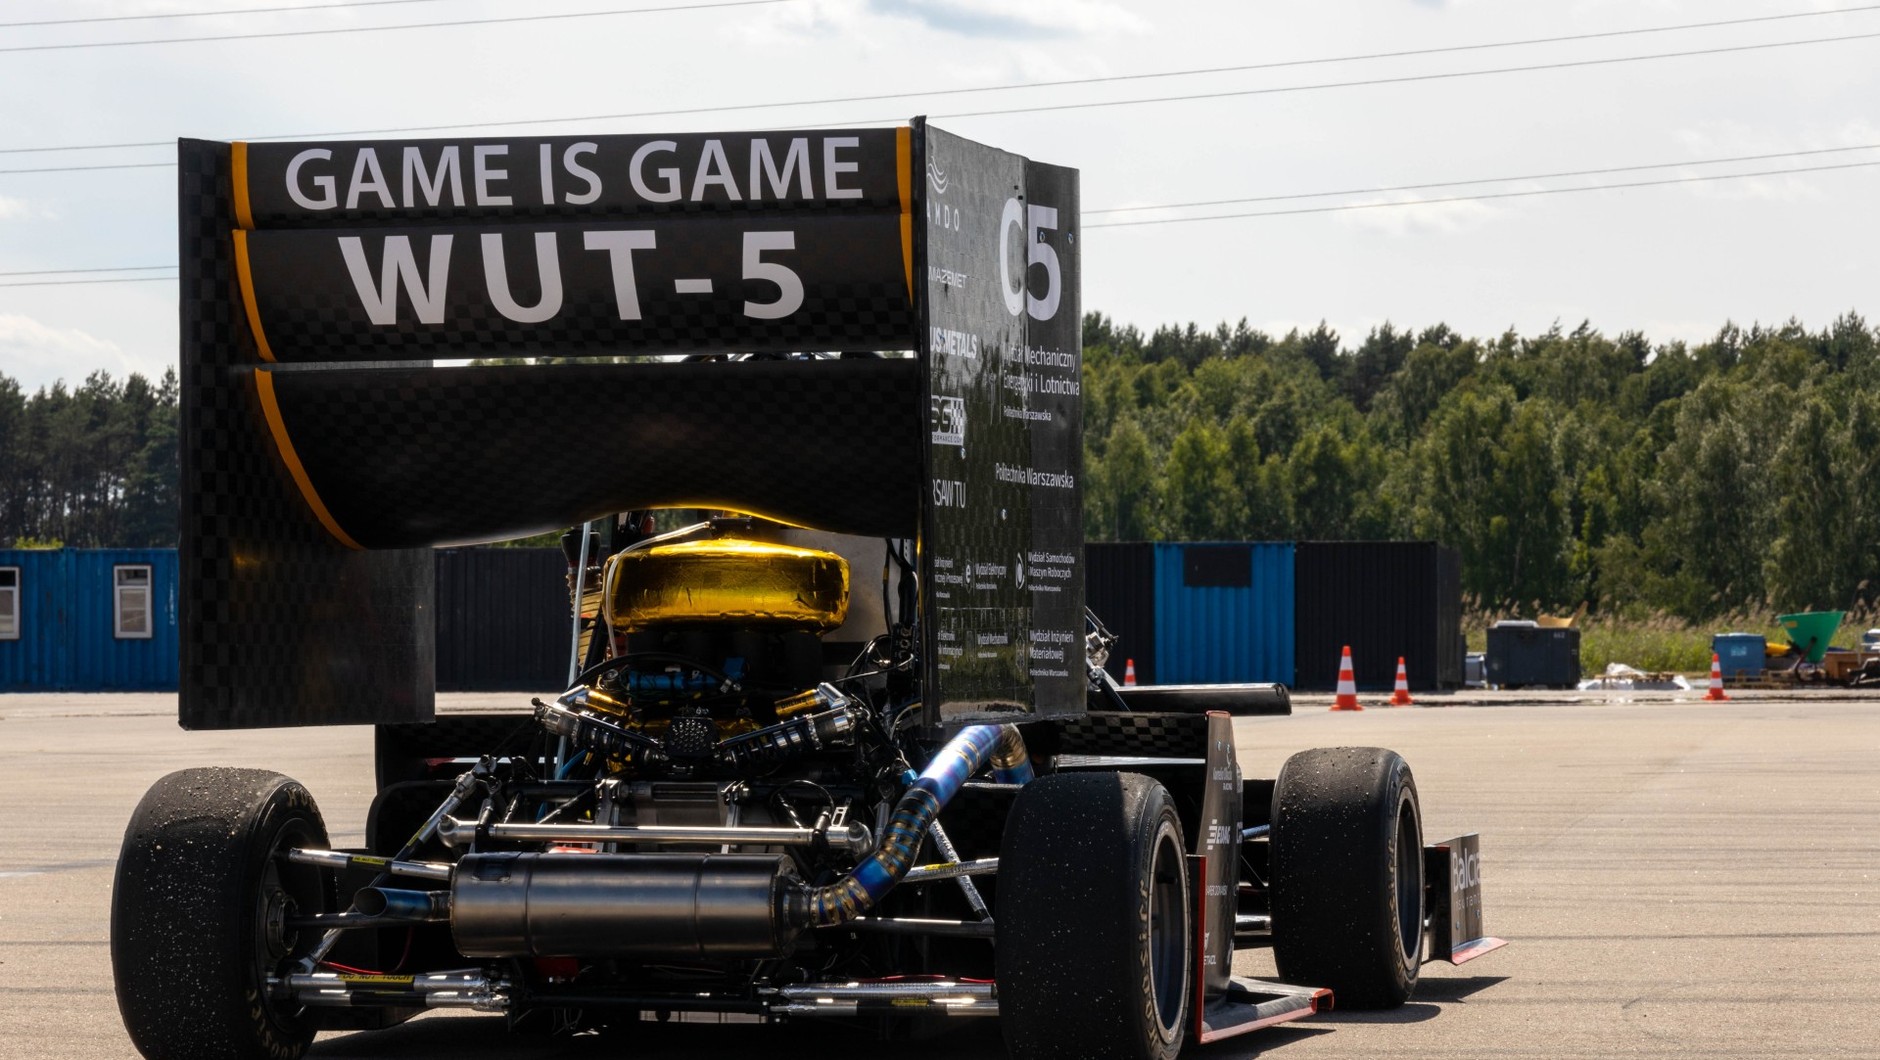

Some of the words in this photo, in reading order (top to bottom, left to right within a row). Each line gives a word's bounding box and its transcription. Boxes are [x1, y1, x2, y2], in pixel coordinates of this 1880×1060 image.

[285, 144, 514, 211] GAME
[539, 141, 603, 205] IS
[629, 136, 864, 203] GAME
[1025, 344, 1077, 374] Mechaniczny
[1035, 372, 1038, 393] i
[1040, 374, 1080, 397] Lotnictwa
[995, 462, 1026, 485] Politechnika
[1026, 466, 1075, 489] Warszawska
